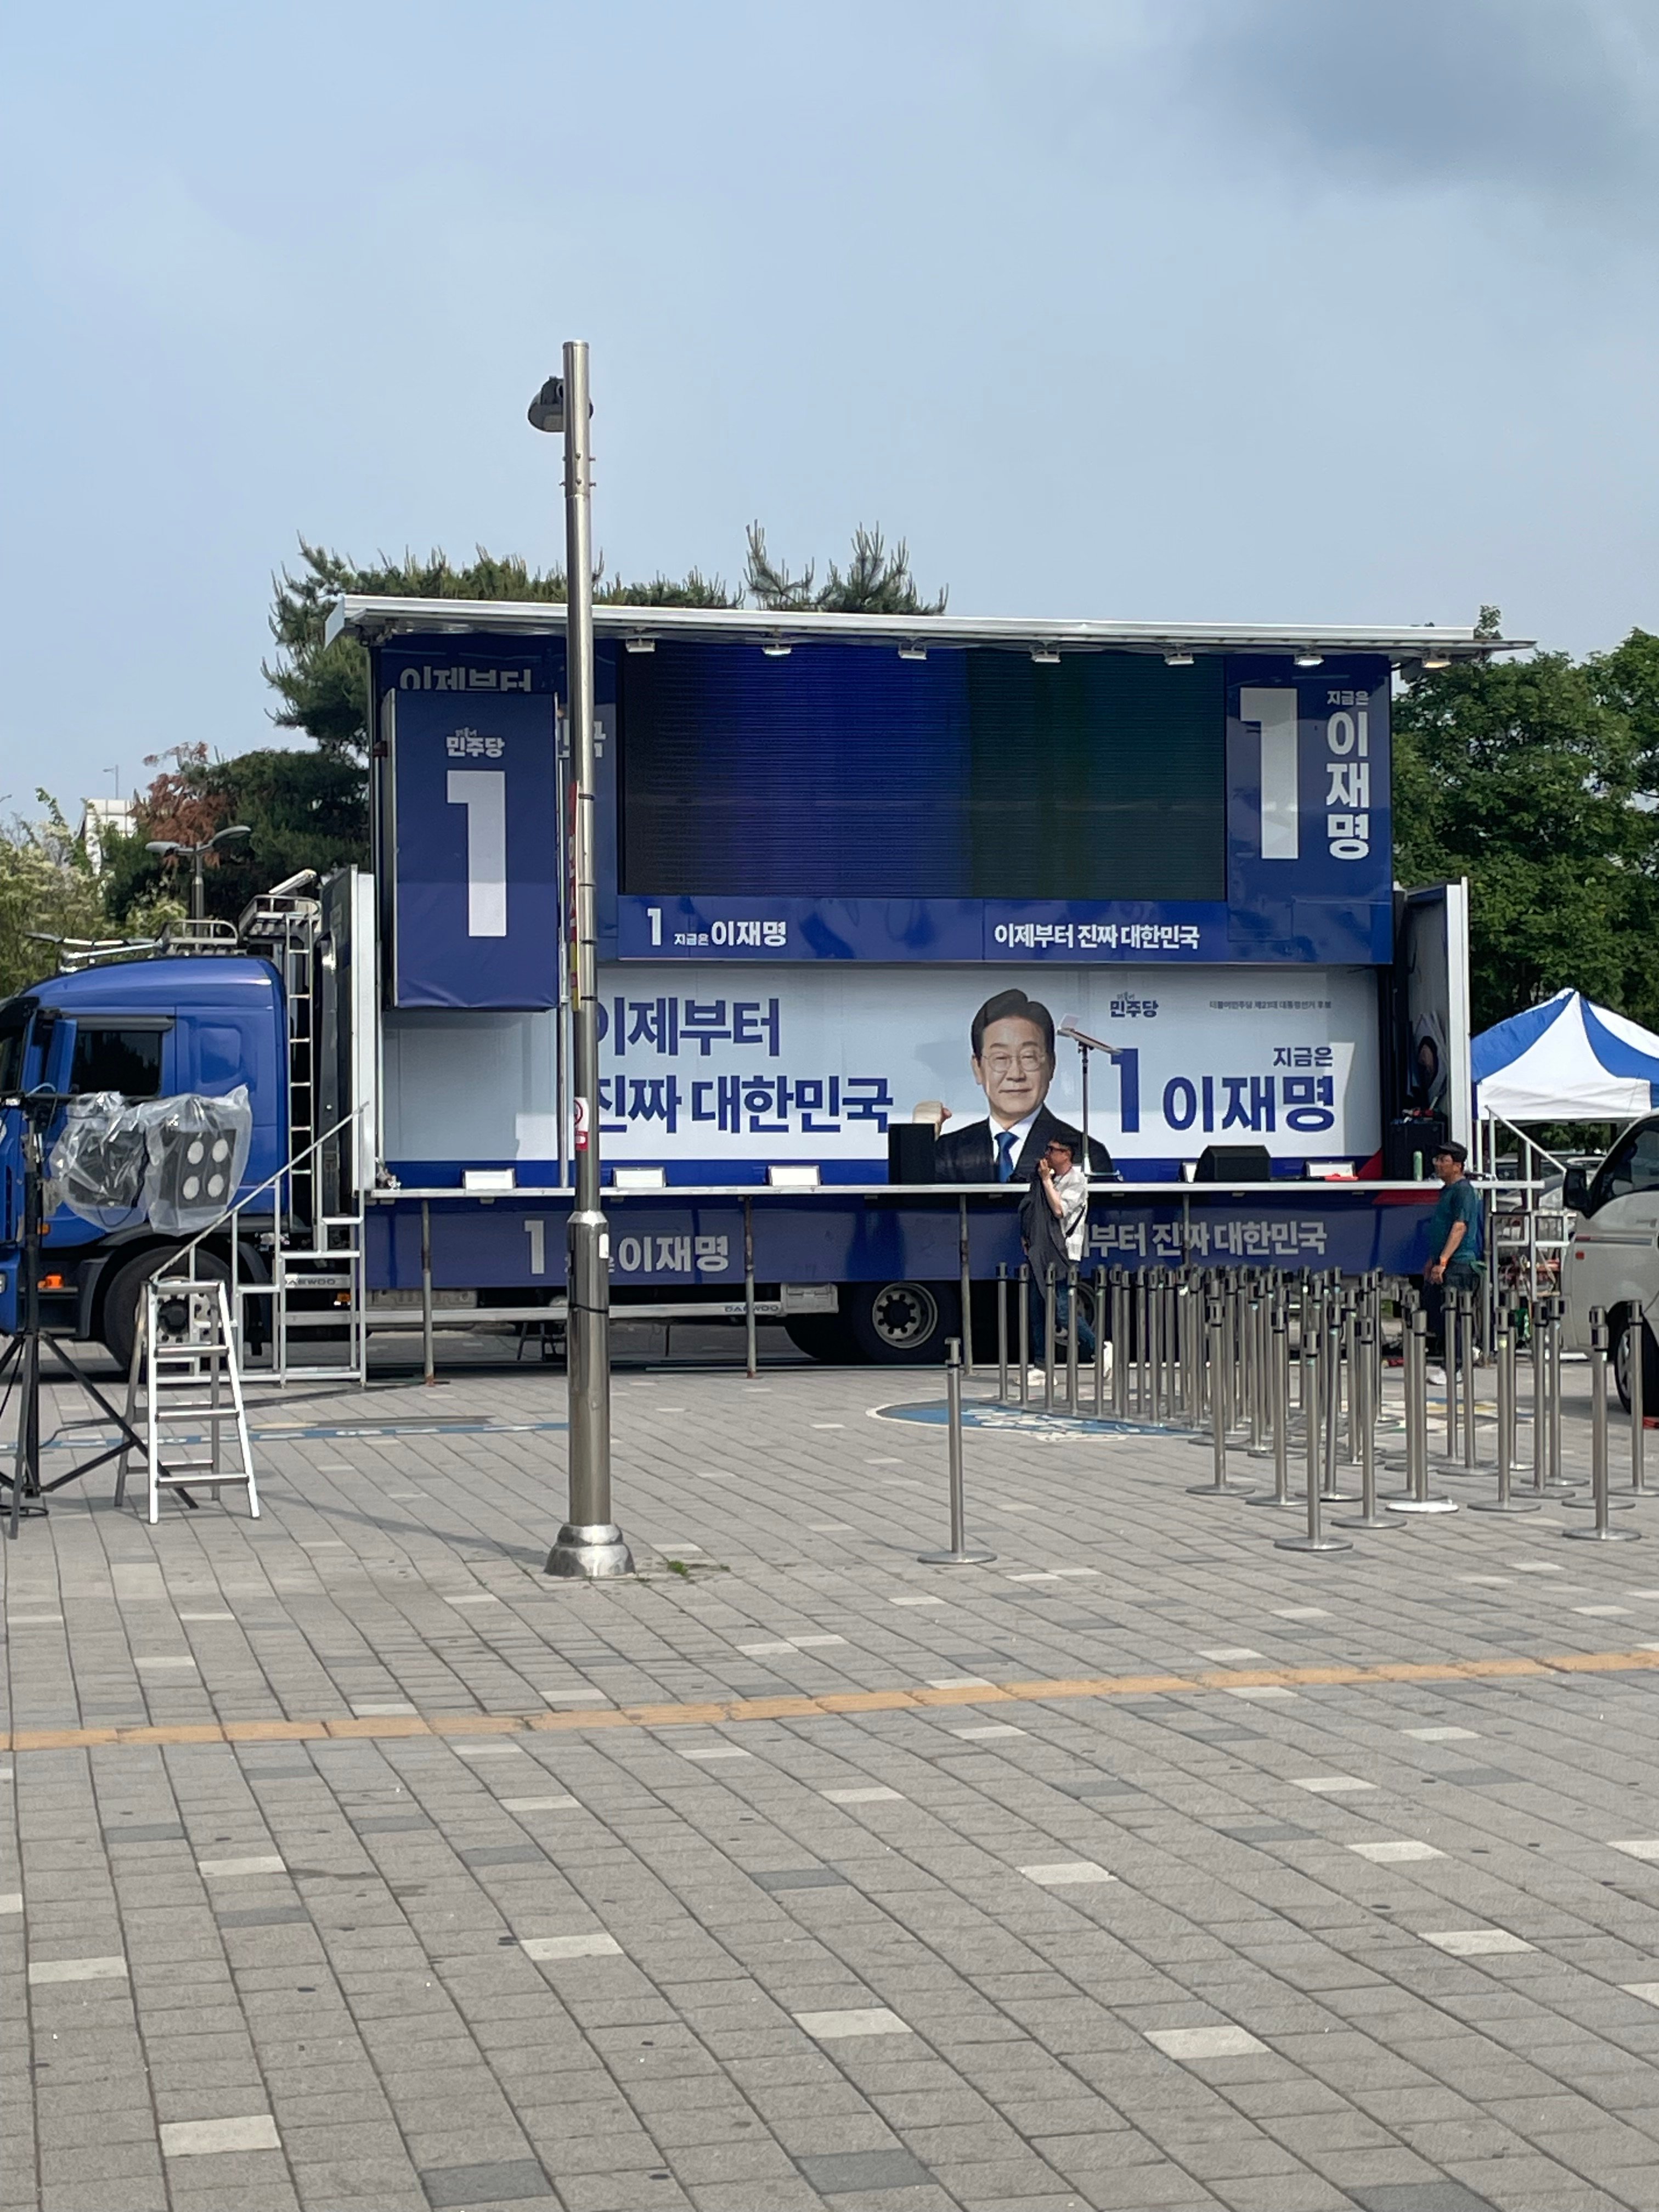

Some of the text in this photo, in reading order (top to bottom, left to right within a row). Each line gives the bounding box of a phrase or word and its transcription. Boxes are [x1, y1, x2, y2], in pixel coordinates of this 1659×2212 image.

[1327, 691, 1369, 705] 지금은
[447, 737, 505, 758] 민주당
[1240, 687, 1299, 859] 1
[1326, 712, 1369, 860] 이재명
[447, 770, 506, 936] 1
[647, 908, 787, 946] 1 지금은 이재명
[994, 923, 1200, 950] 이제부터 진짜 대한민국
[597, 997, 780, 1056] 이제부터
[1110, 1001, 1159, 1018] 민주당
[1273, 1047, 1333, 1067] 지금은
[598, 1075, 893, 1133] 진짜 대한민국
[1111, 1048, 1335, 1133] 1 이재명
[524, 1220, 544, 1274] 1
[618, 1236, 729, 1272] 이재명
[1214, 1221, 1327, 1256] 대한민국
